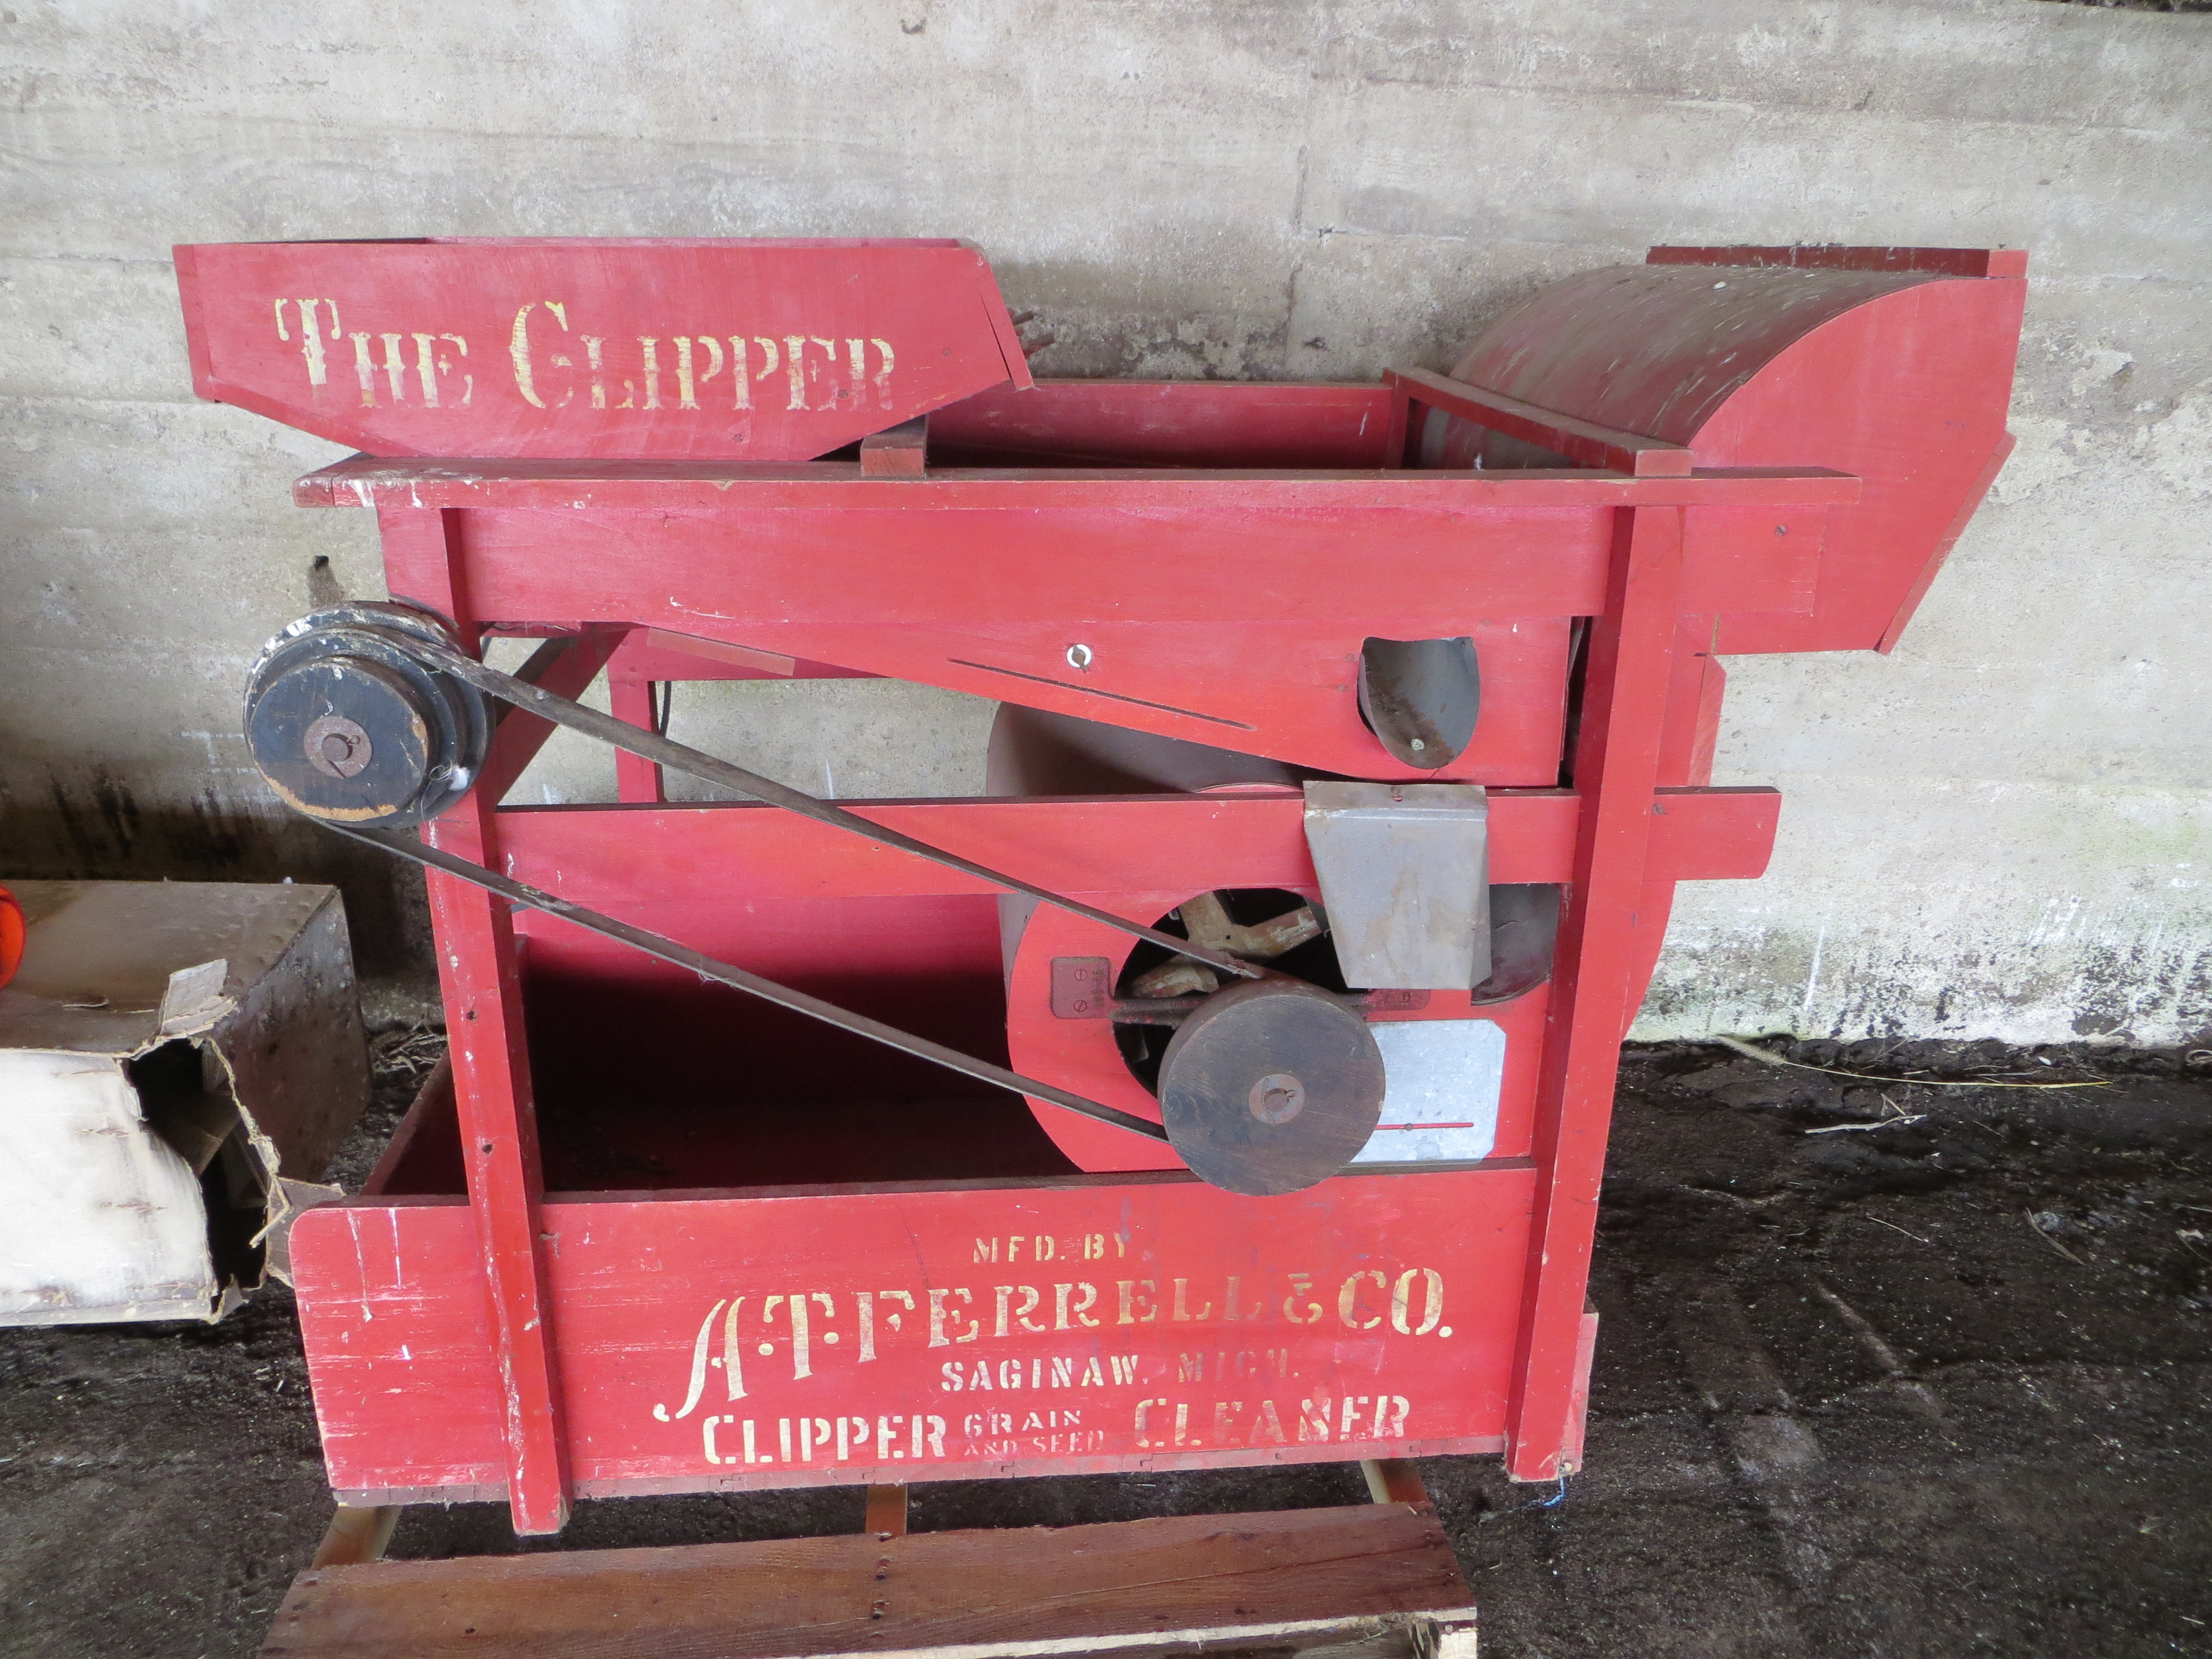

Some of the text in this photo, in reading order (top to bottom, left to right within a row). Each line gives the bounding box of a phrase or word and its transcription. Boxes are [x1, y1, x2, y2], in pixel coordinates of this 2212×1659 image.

[274, 298, 895, 411] THE CLIPPER
[973, 1232, 1126, 1264] MFD. BY
[1338, 1267, 1453, 1338] CO.
[703, 1395, 1410, 1465] CLIPPER GRAIN CLEANER
[964, 1430, 1104, 1456] AND SEED
